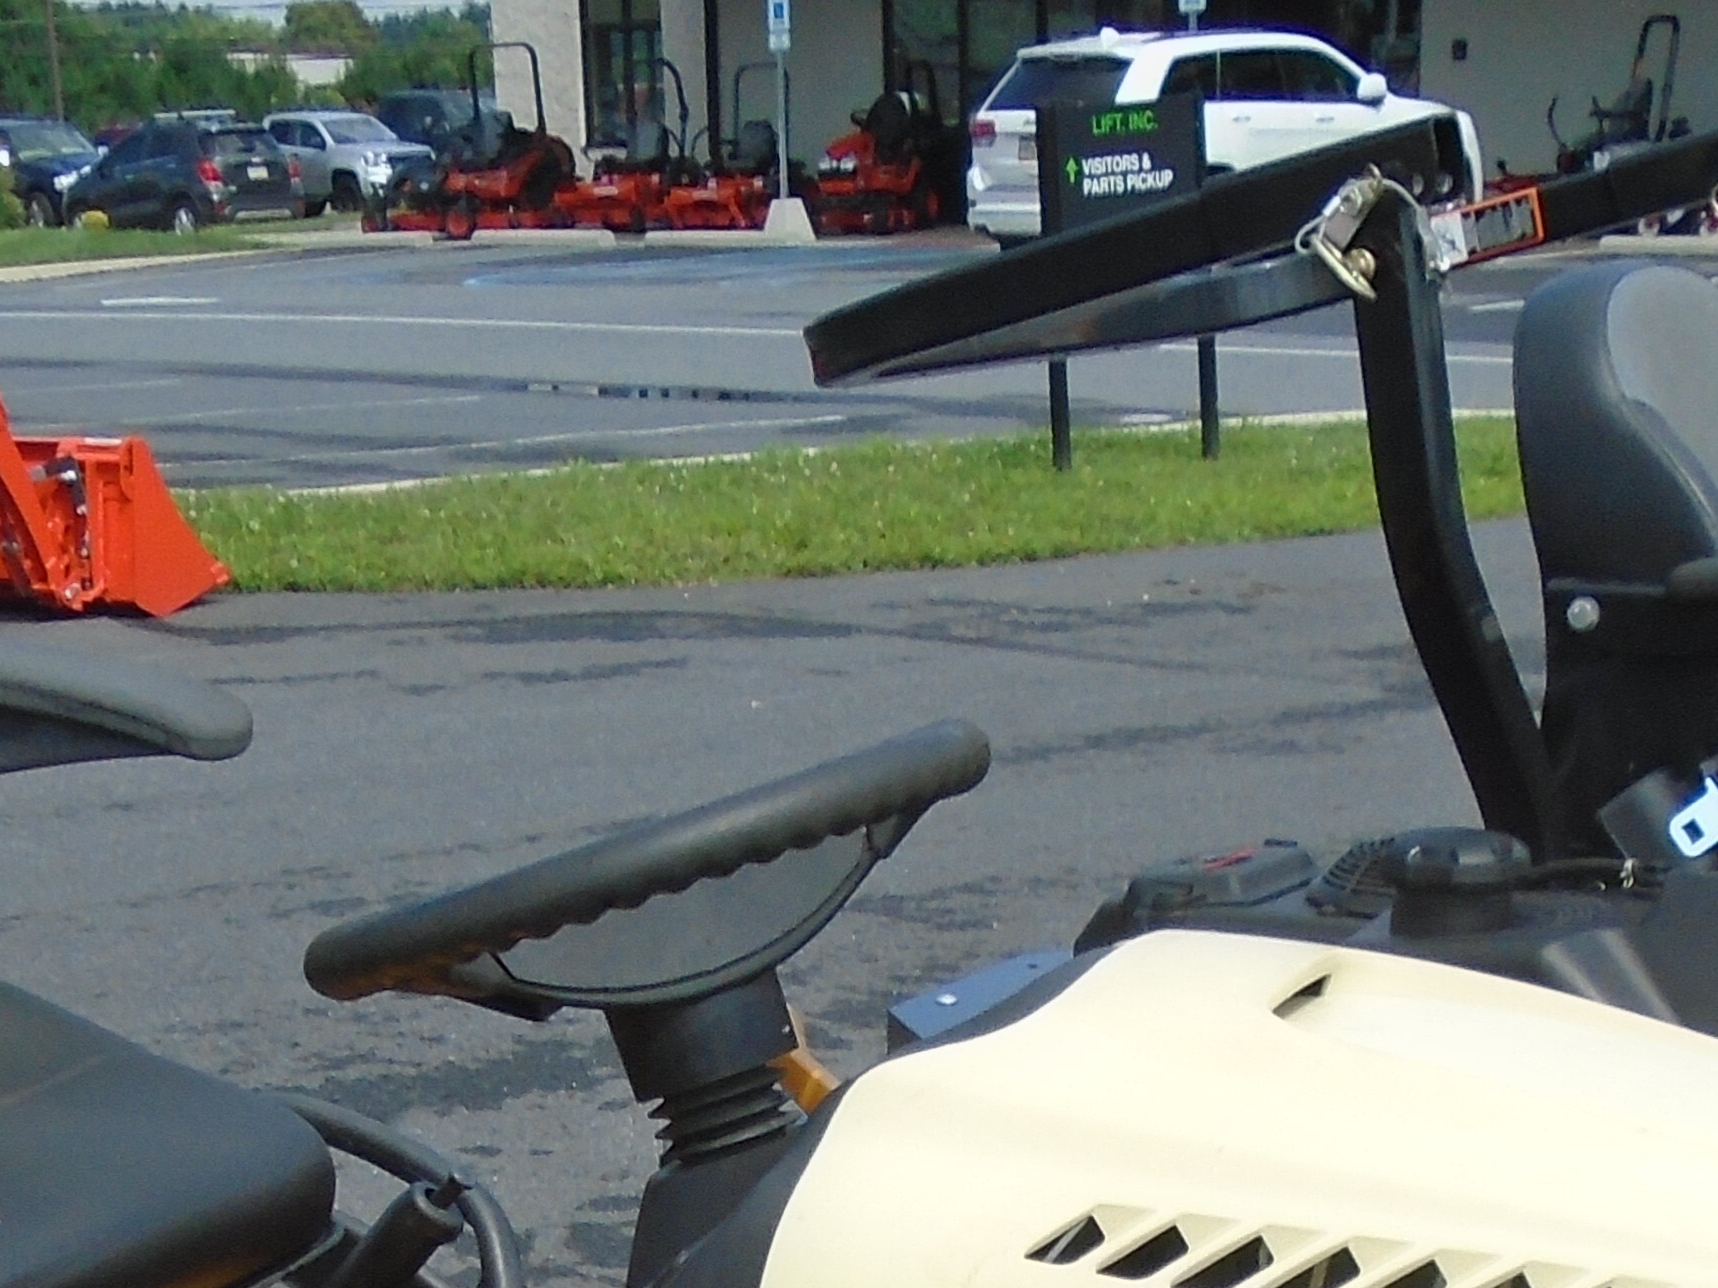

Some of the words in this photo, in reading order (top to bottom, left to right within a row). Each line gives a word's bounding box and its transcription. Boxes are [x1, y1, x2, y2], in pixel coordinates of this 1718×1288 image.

[1082, 152, 1140, 175] VISITORS
[1142, 151, 1152, 171] &
[1083, 174, 1124, 197] PARTS
[1127, 168, 1174, 194] PICKUP
